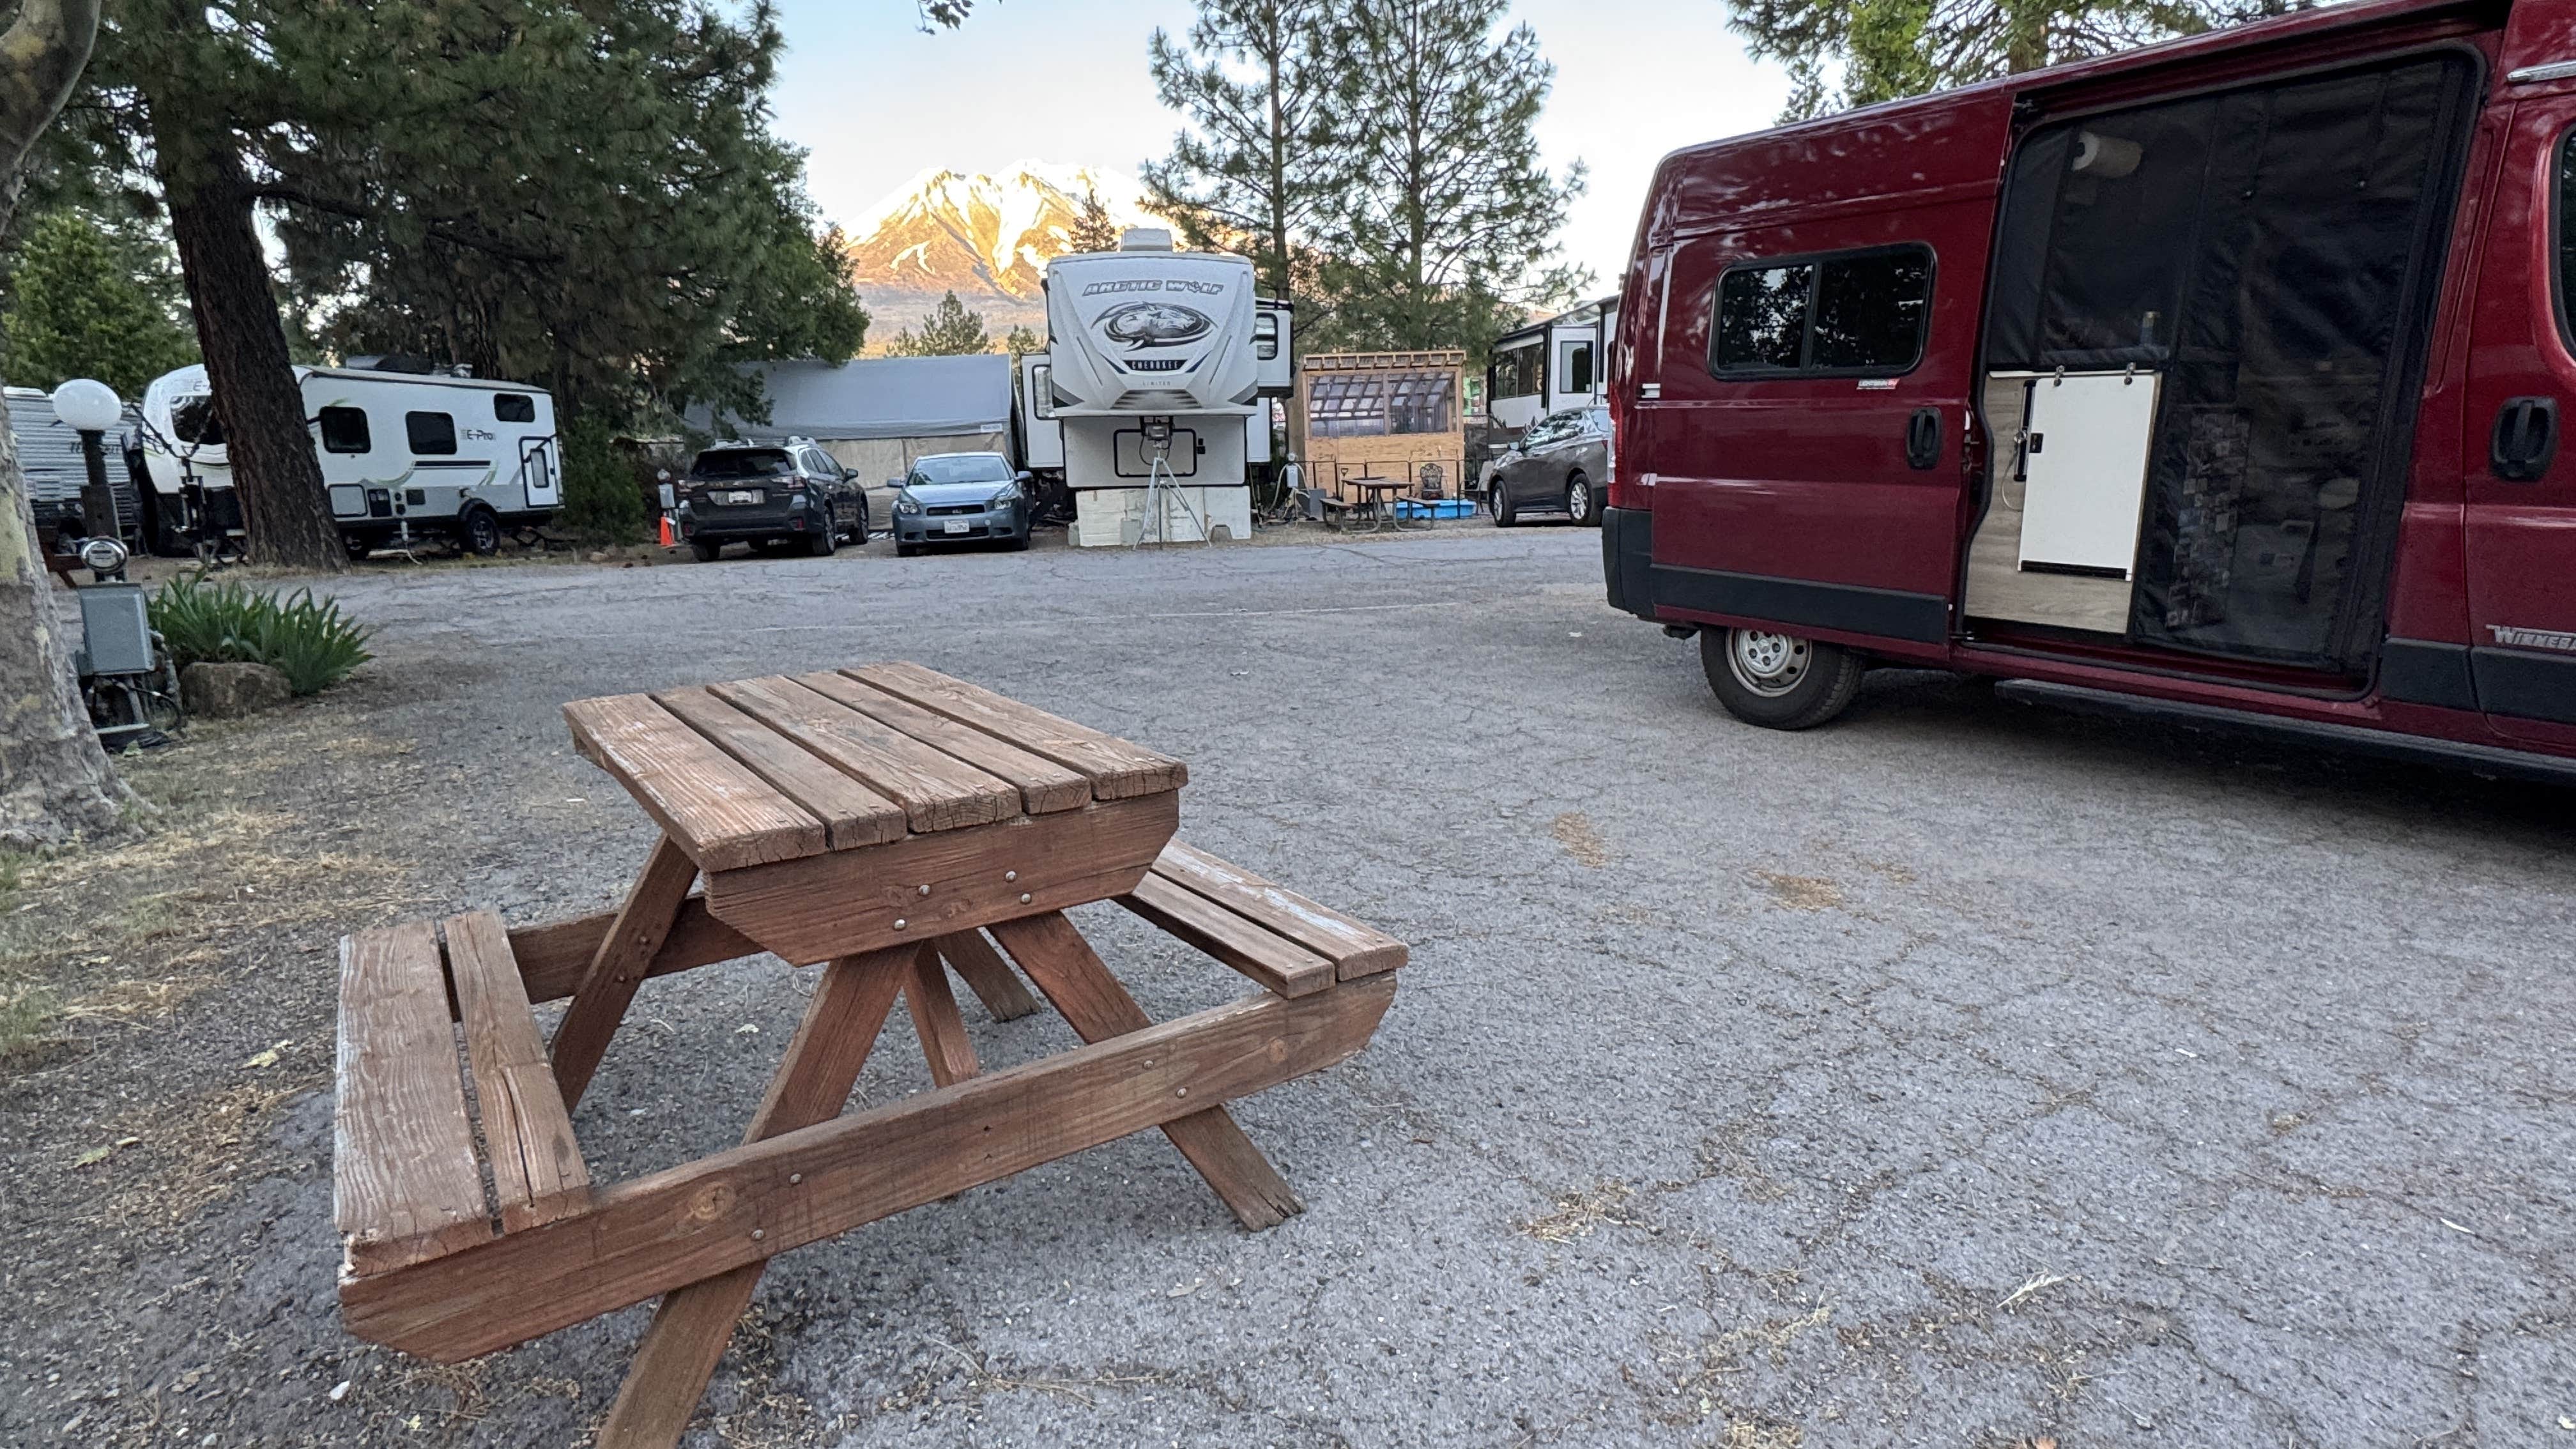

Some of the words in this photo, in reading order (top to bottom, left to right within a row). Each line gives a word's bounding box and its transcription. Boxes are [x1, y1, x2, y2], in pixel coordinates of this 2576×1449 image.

[1082, 280, 1163, 296] ARCTIC
[1131, 360, 1178, 369] CHEROKEE
[466, 429, 494, 440] E-Pro
